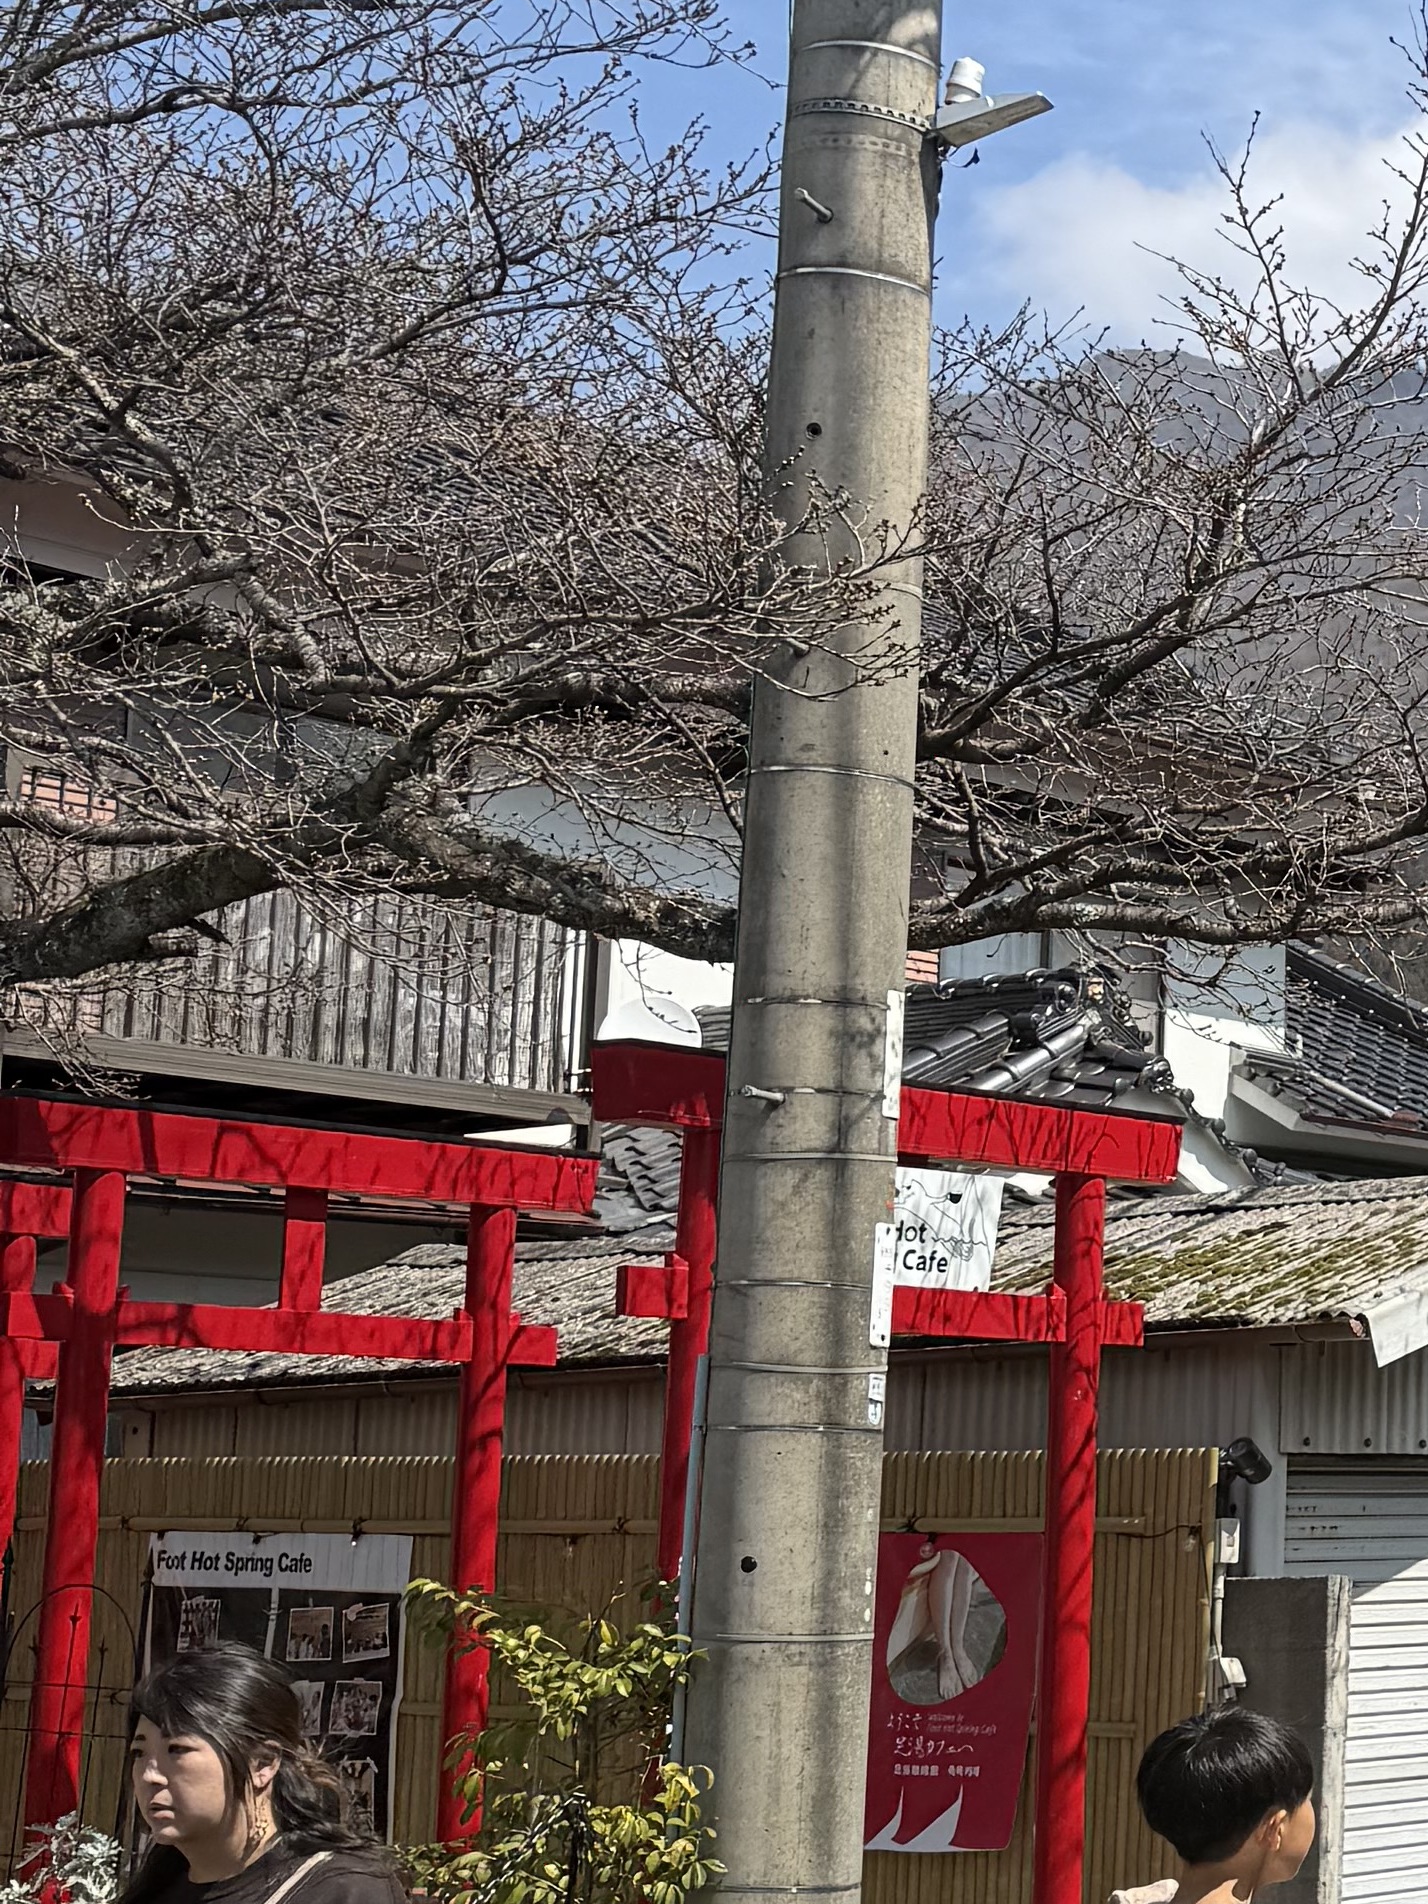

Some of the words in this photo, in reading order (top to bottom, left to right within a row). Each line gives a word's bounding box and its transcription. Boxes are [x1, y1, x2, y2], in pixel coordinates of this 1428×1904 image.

[903, 1249, 948, 1273] Cafe
[157, 1549, 187, 1571] Foot
[190, 1550, 220, 1572] Hot
[224, 1551, 274, 1578] Spring
[278, 1552, 313, 1573] Cafe
